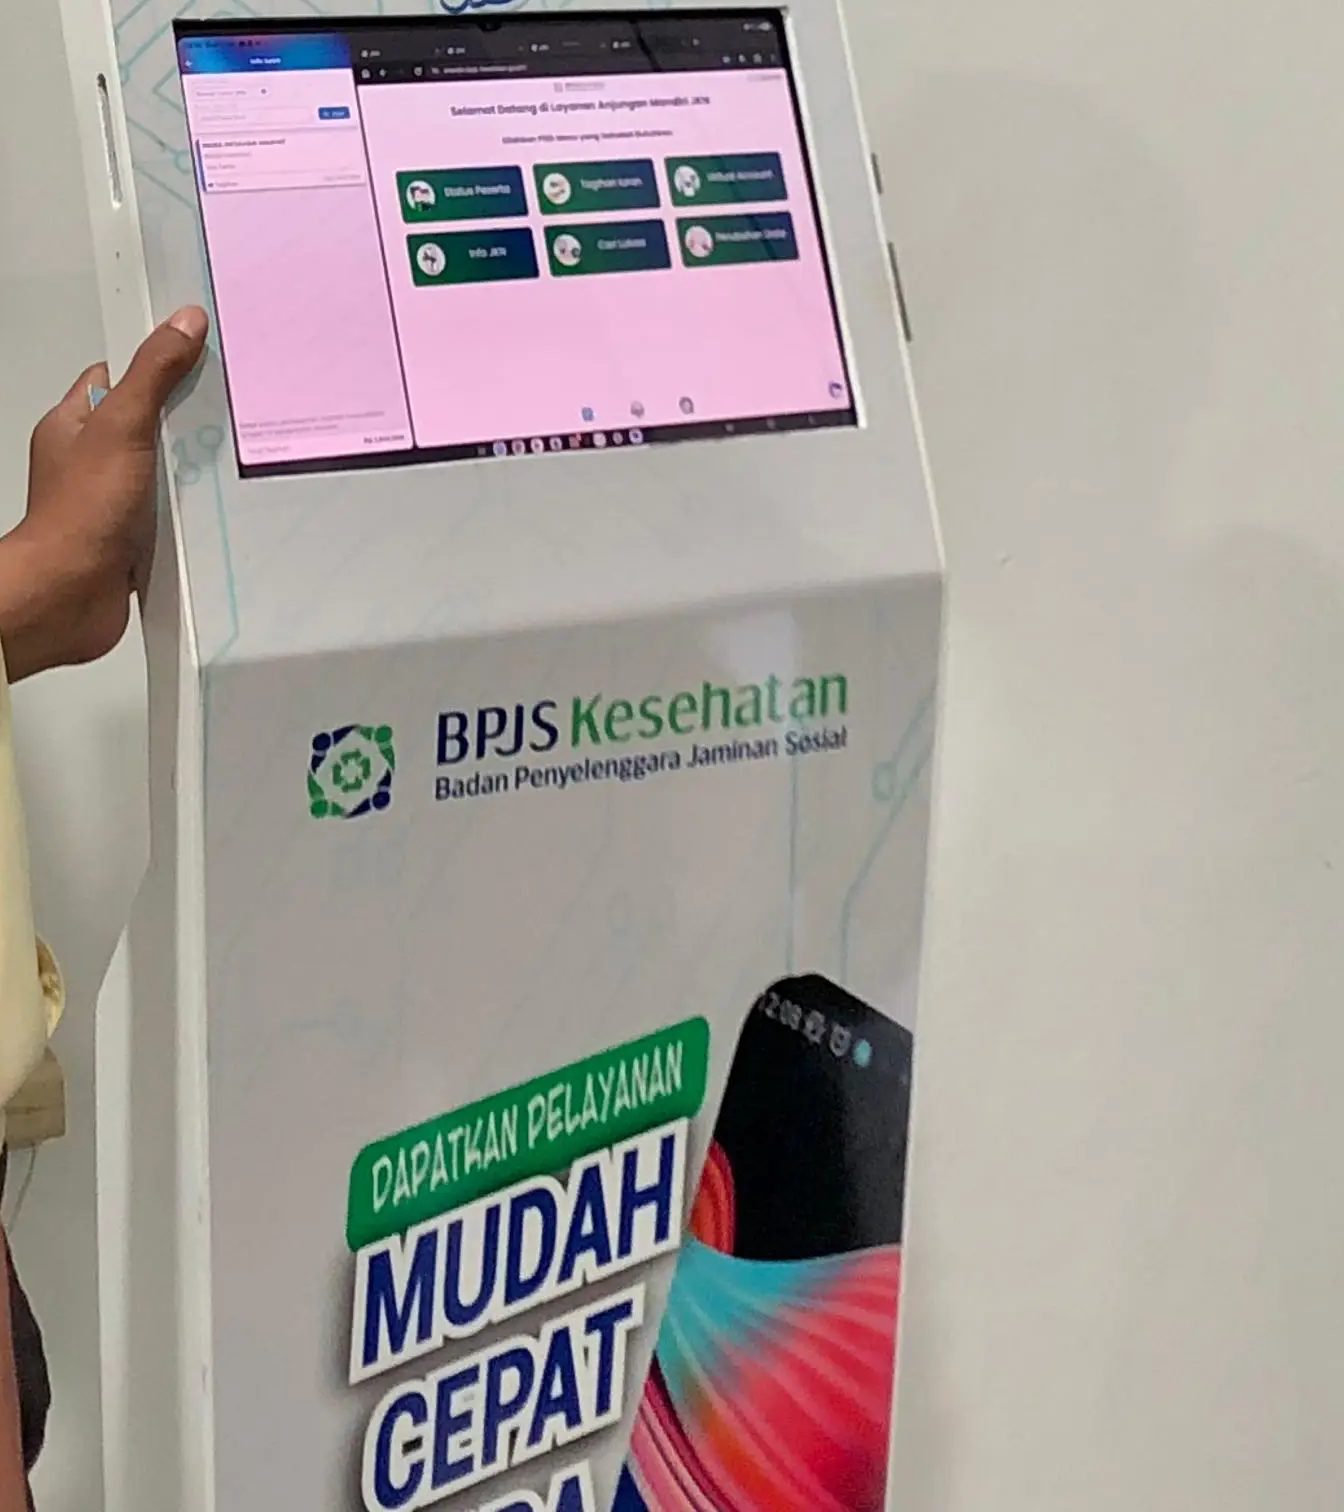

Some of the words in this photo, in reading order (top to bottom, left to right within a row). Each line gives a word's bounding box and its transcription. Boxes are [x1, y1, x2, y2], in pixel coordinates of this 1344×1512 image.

[435, 774, 509, 802] Badan
[514, 749, 682, 791] Penyelenggara
[687, 736, 778, 769] Jaminan
[785, 726, 848, 757] Sosial
[436, 699, 559, 767] BPJS
[570, 672, 848, 750] Kesehatan
[371, 1104, 519, 1214] DAPATKAN
[526, 1039, 684, 1149] PELAYANAN
[359, 1133, 678, 1370] MUDAH
[371, 1298, 635, 1510] CEPAT
